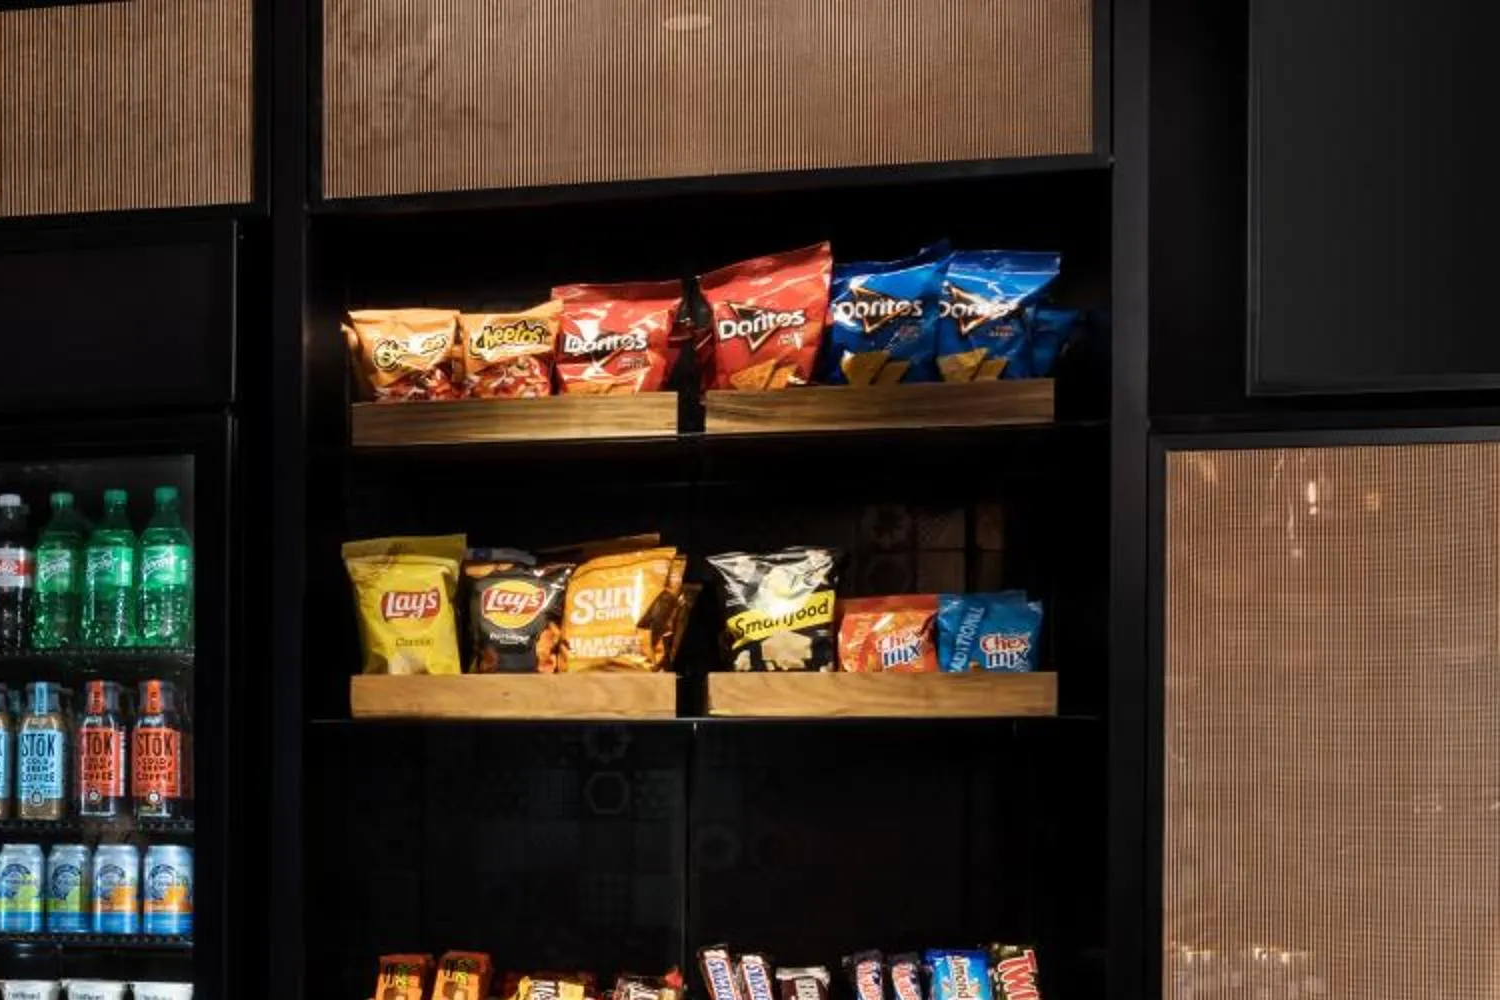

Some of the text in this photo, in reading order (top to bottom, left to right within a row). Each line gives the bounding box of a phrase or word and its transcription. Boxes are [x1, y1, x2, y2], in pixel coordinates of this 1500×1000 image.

[836, 298, 924, 321] Doritos
[719, 309, 805, 340] Doritos
[470, 320, 545, 356] Cheetos
[562, 330, 648, 354] Doritos
[980, 634, 1032, 655] Chex
